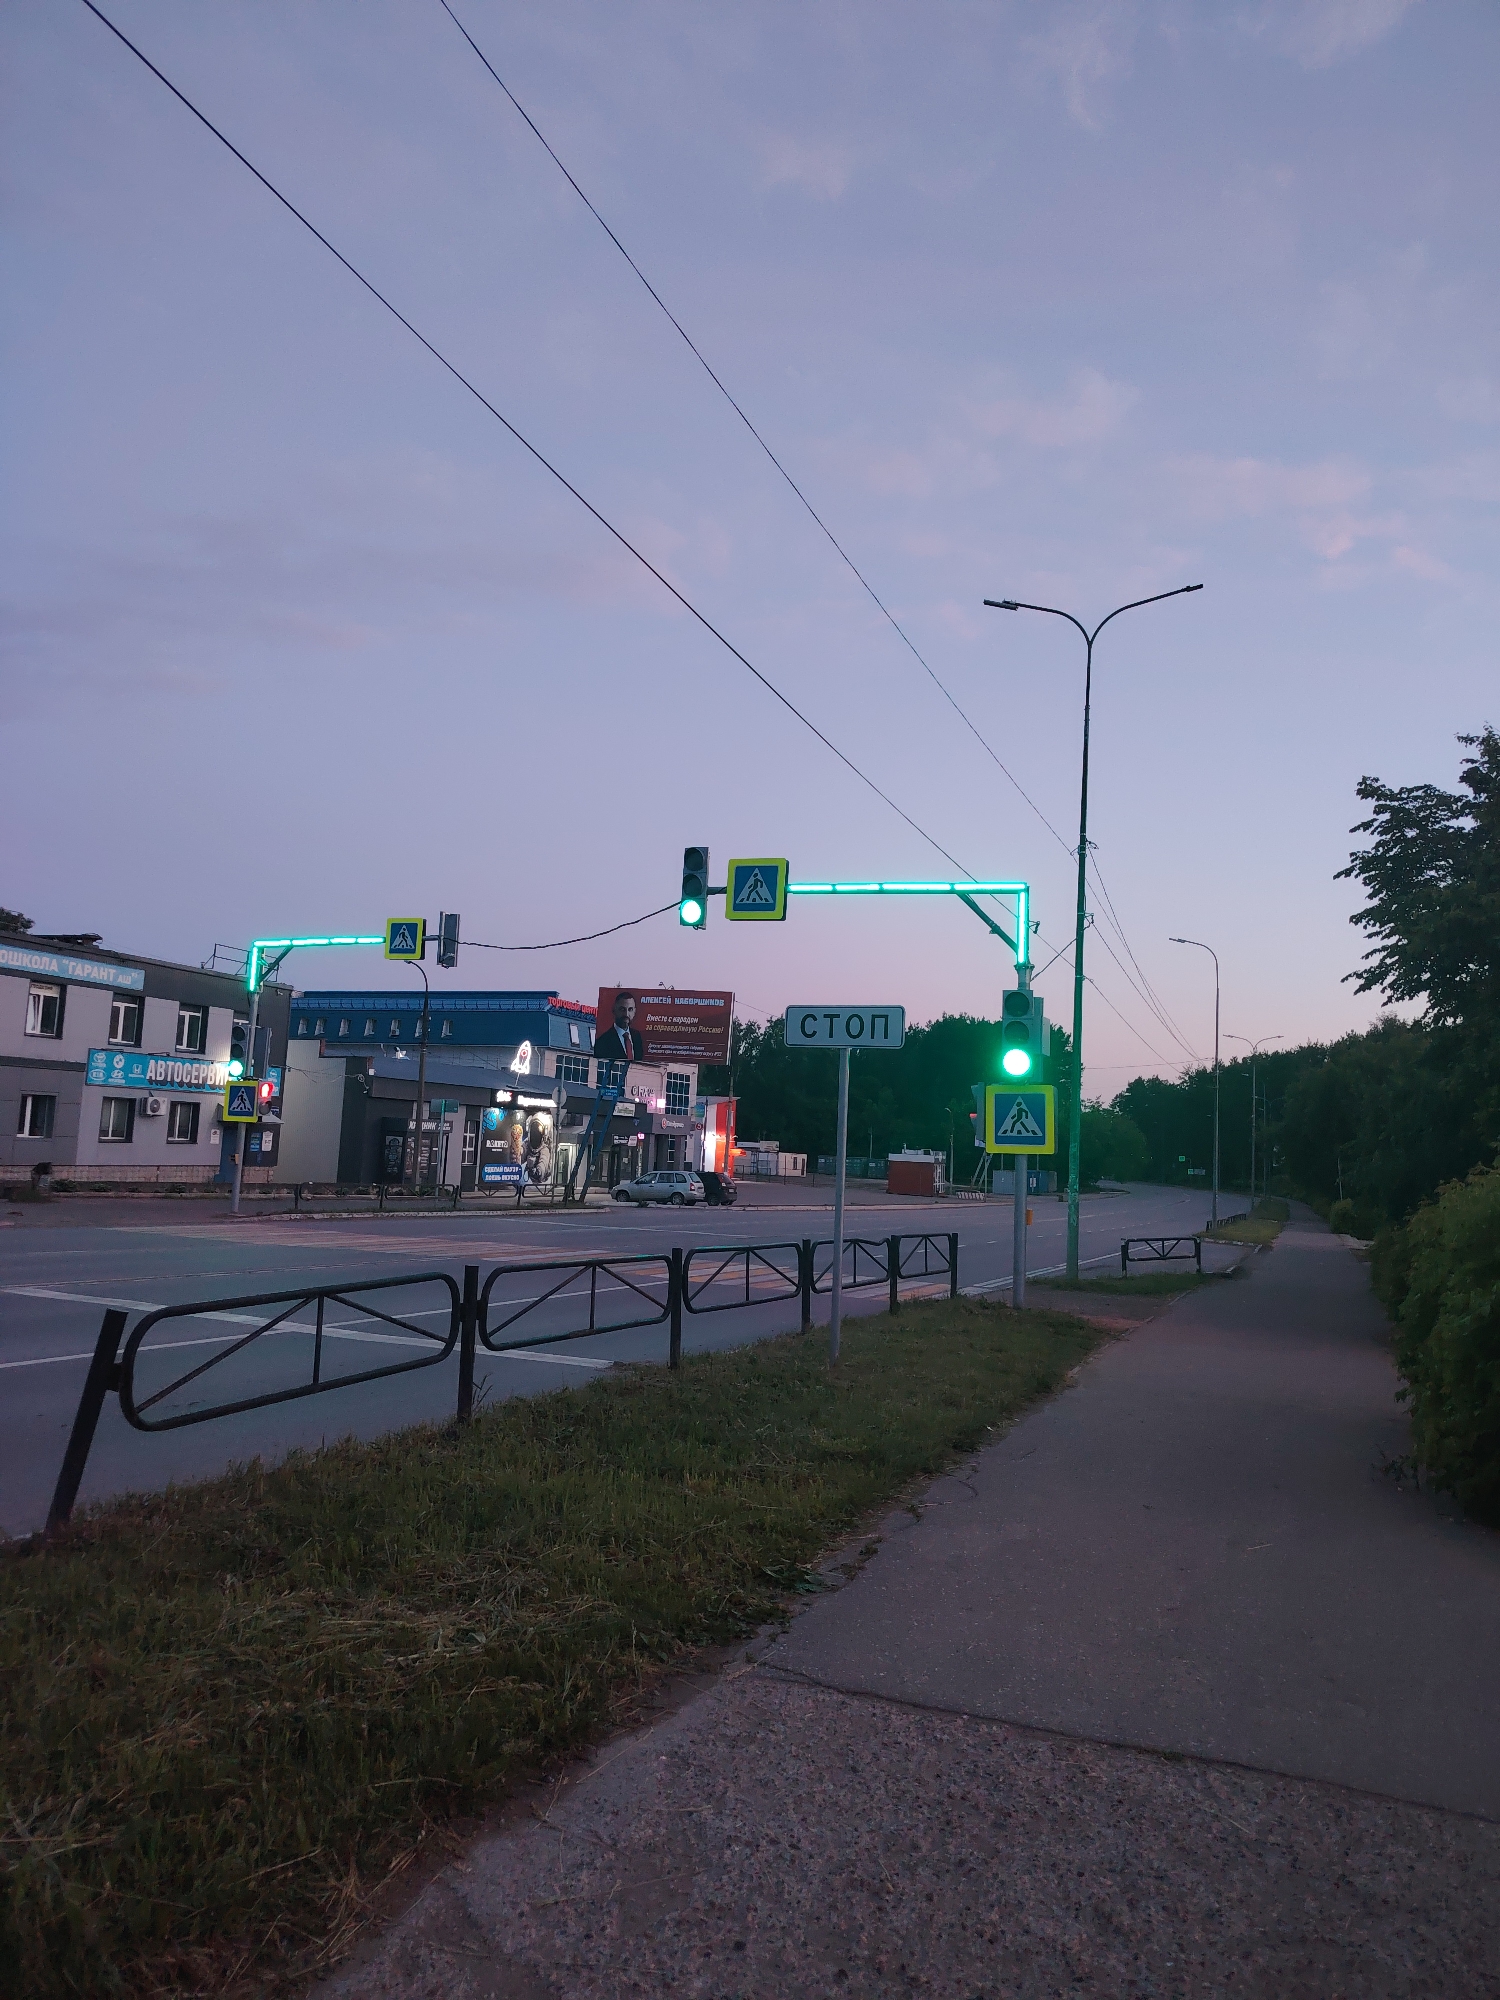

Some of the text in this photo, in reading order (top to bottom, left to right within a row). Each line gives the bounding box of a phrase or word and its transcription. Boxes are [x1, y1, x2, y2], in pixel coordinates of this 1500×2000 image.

[640, 995, 671, 1004] АЛЕКСЕЙ
[646, 1013, 667, 1022] Вместе
[672, 1016, 699, 1025] народом
[653, 1024, 697, 1034] справедливую
[698, 1025, 724, 1034] Россию!
[800, 1013, 889, 1040] СТОП
[146, 1059, 229, 1086] АВТОСЕРВИ
